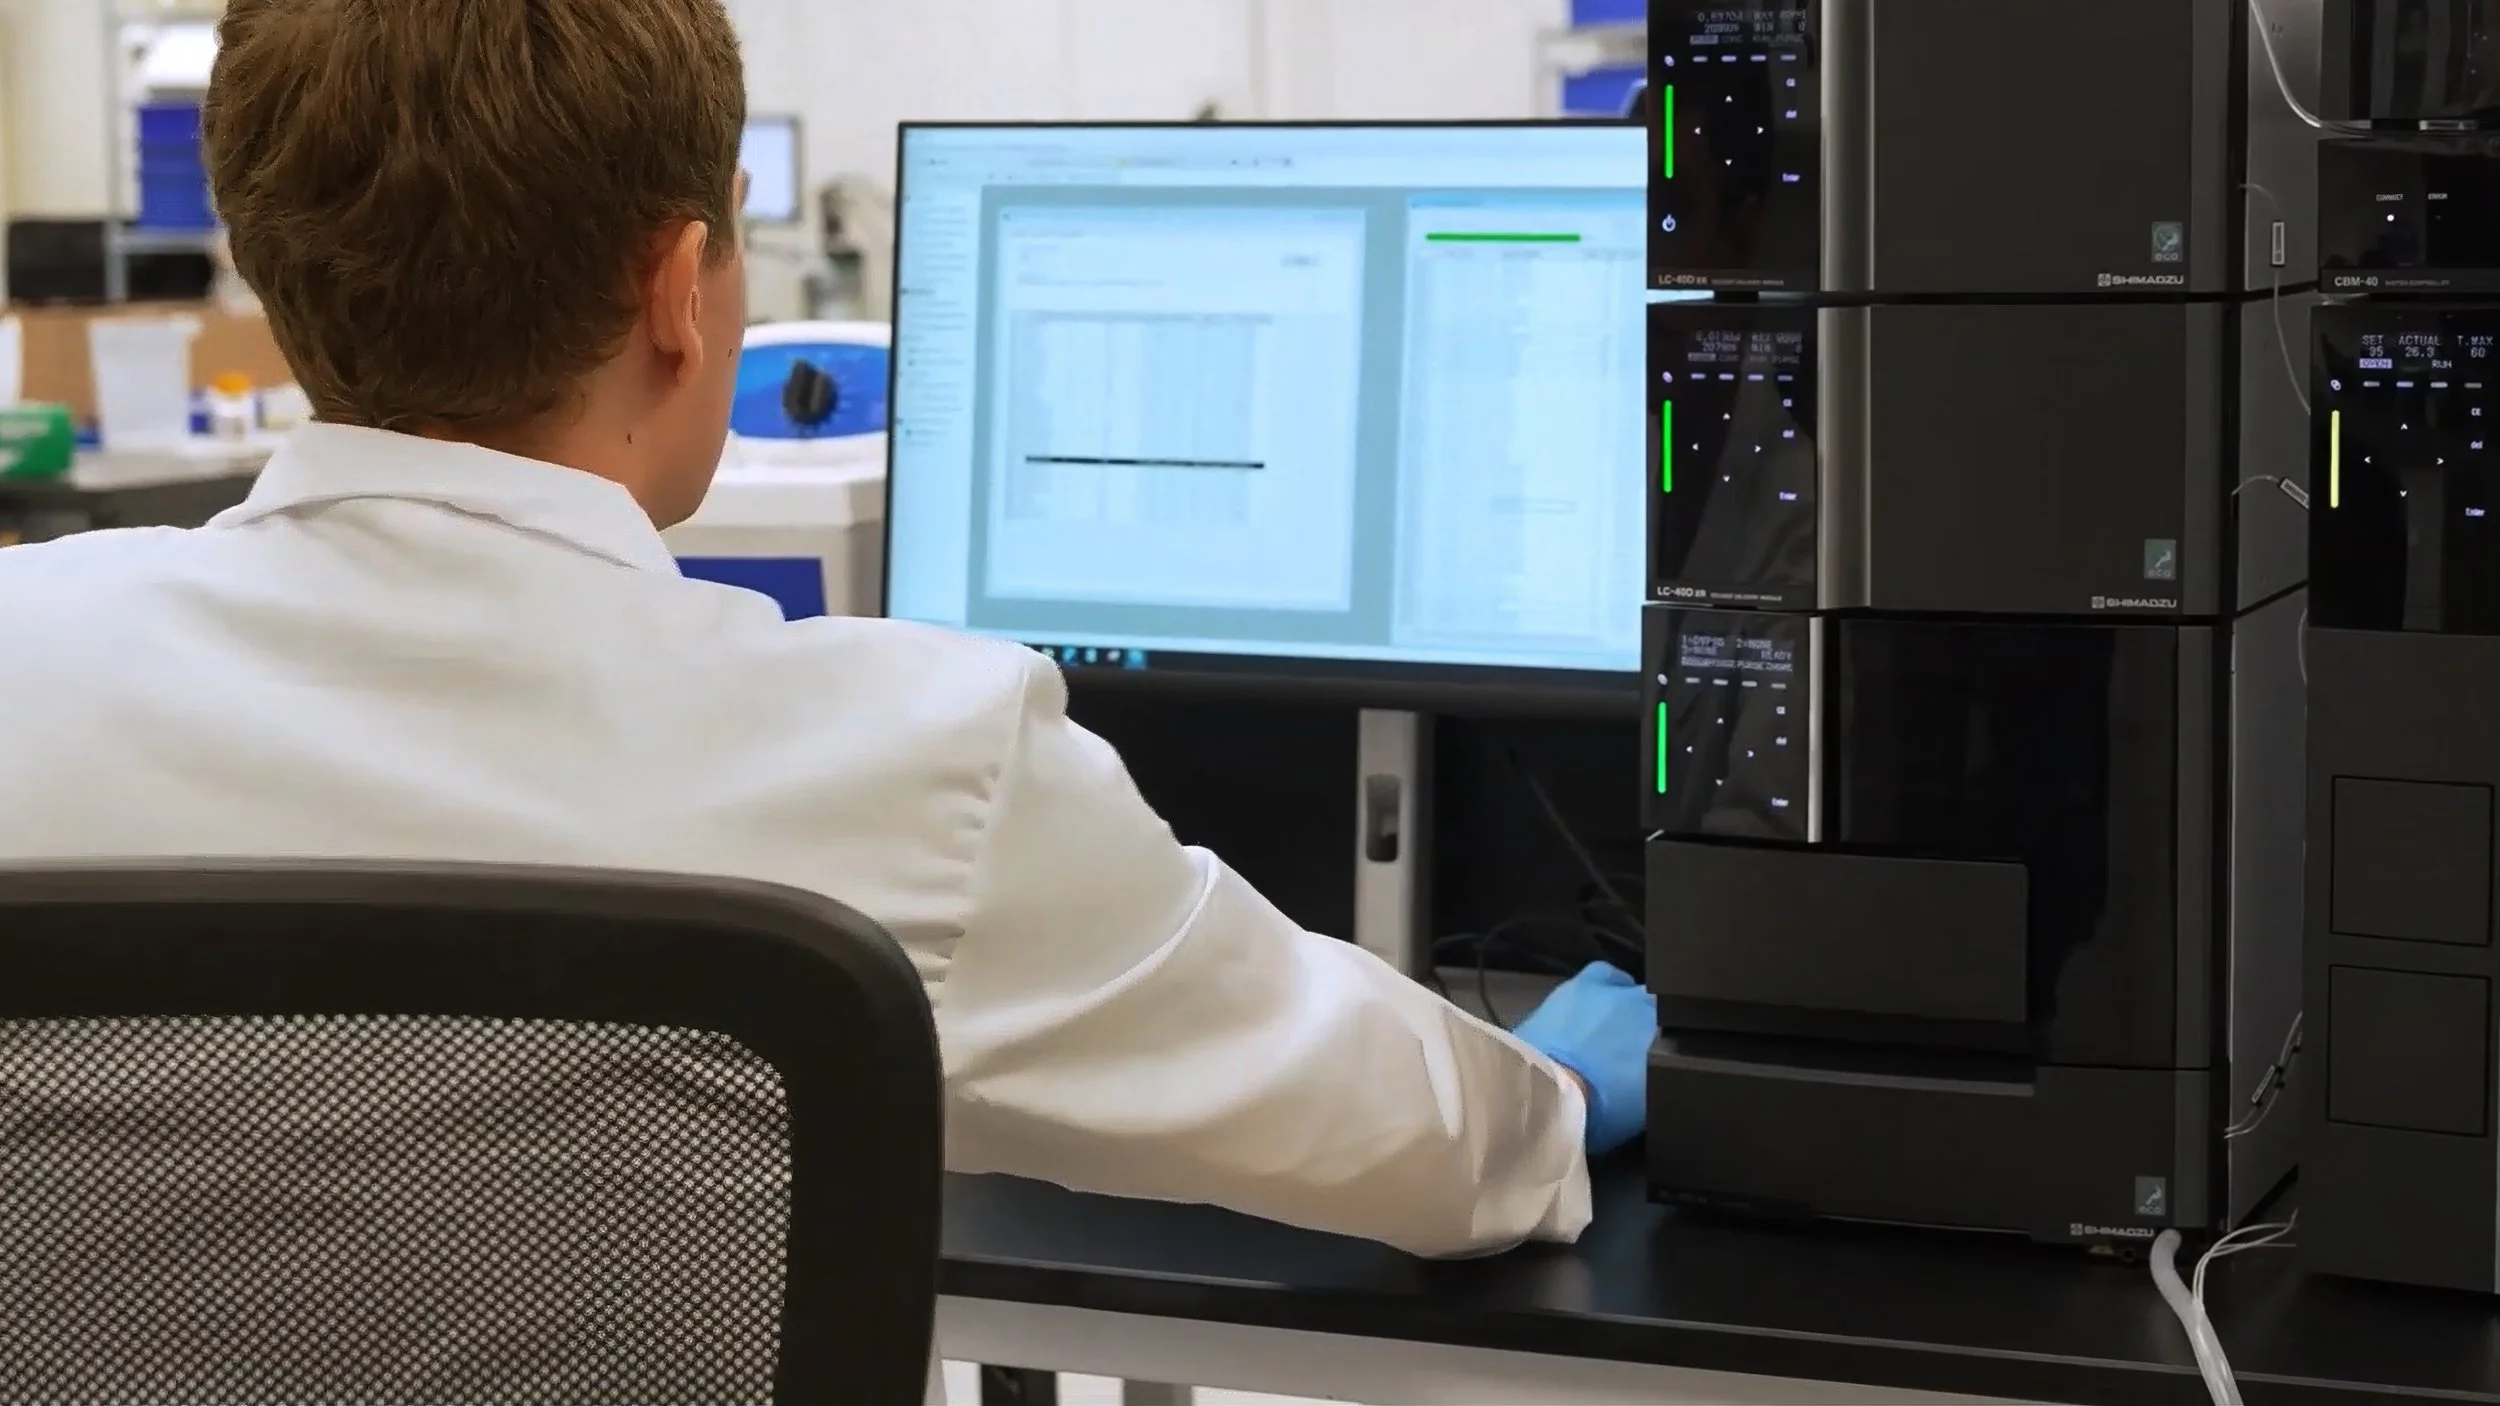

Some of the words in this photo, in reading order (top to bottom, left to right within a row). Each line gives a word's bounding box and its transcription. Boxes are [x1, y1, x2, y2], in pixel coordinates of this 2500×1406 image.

[2111, 275, 2184, 285] SHIMADZU
[2334, 275, 2379, 287] CBM-40
[2361, 334, 2384, 345] SET
[2398, 335, 2441, 346] ACTUAL
[2456, 335, 2493, 346] T.MAX
[2368, 345, 2384, 357] 35
[2404, 346, 2435, 357] 26.3
[2470, 346, 2486, 358] 60
[1657, 586, 1694, 597] LC-40D
[2106, 598, 2177, 608] SHIMADZU
[2084, 1225, 2154, 1238] SHIMADZU
